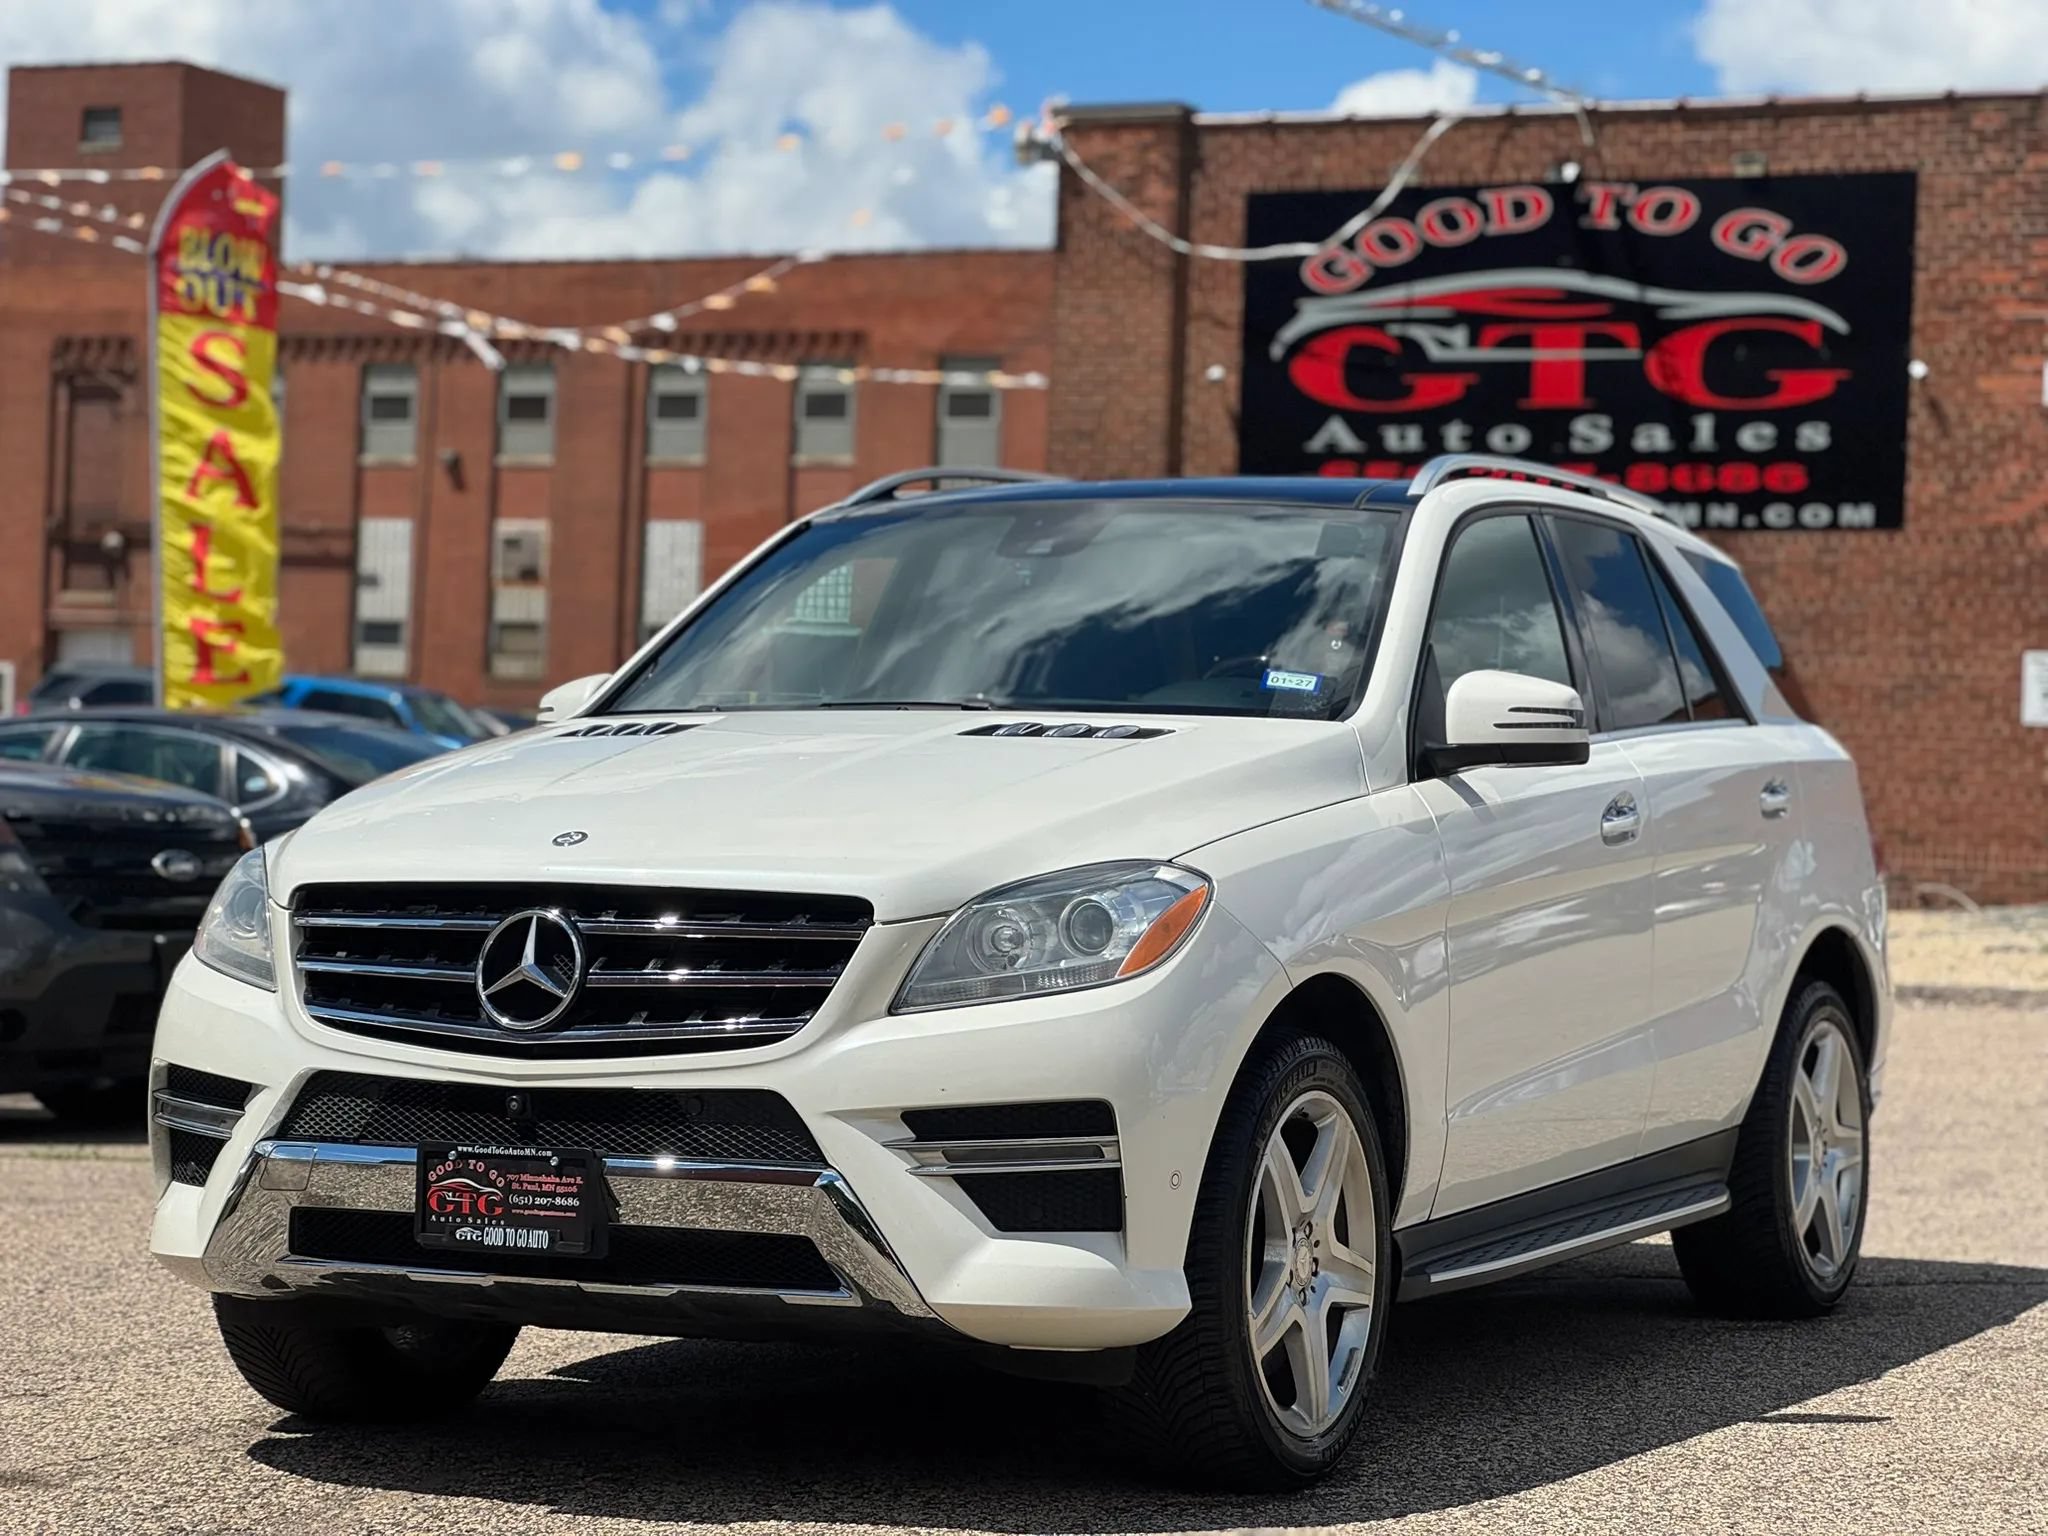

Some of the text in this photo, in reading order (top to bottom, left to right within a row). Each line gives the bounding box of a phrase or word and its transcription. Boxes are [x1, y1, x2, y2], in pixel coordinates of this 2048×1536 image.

[1301, 183, 1847, 294] GOOD TO GO
[178, 225, 267, 280] BLOW
[174, 275, 256, 321] OUT
[1287, 318, 1853, 413] GTG
[1304, 413, 1832, 454] Auto Sales
[186, 331, 260, 685] SALE
[456, 1145, 553, 1157] www.GoodToGoAutoMN.com
[428, 1159, 505, 1187] GOOD TO GO
[506, 1174, 519, 1182] 707
[561, 1175, 575, 1183] Ave
[508, 1193, 580, 1206] (651) 207-8686
[541, 1183, 555, 1191] MN
[428, 1190, 505, 1216] GTG
[430, 1214, 505, 1226] Auto Sales
[483, 1227, 504, 1246] GOOD
[506, 1228, 515, 1247] TO
[516, 1228, 527, 1248] GO
[527, 1229, 549, 1249] AUTO
